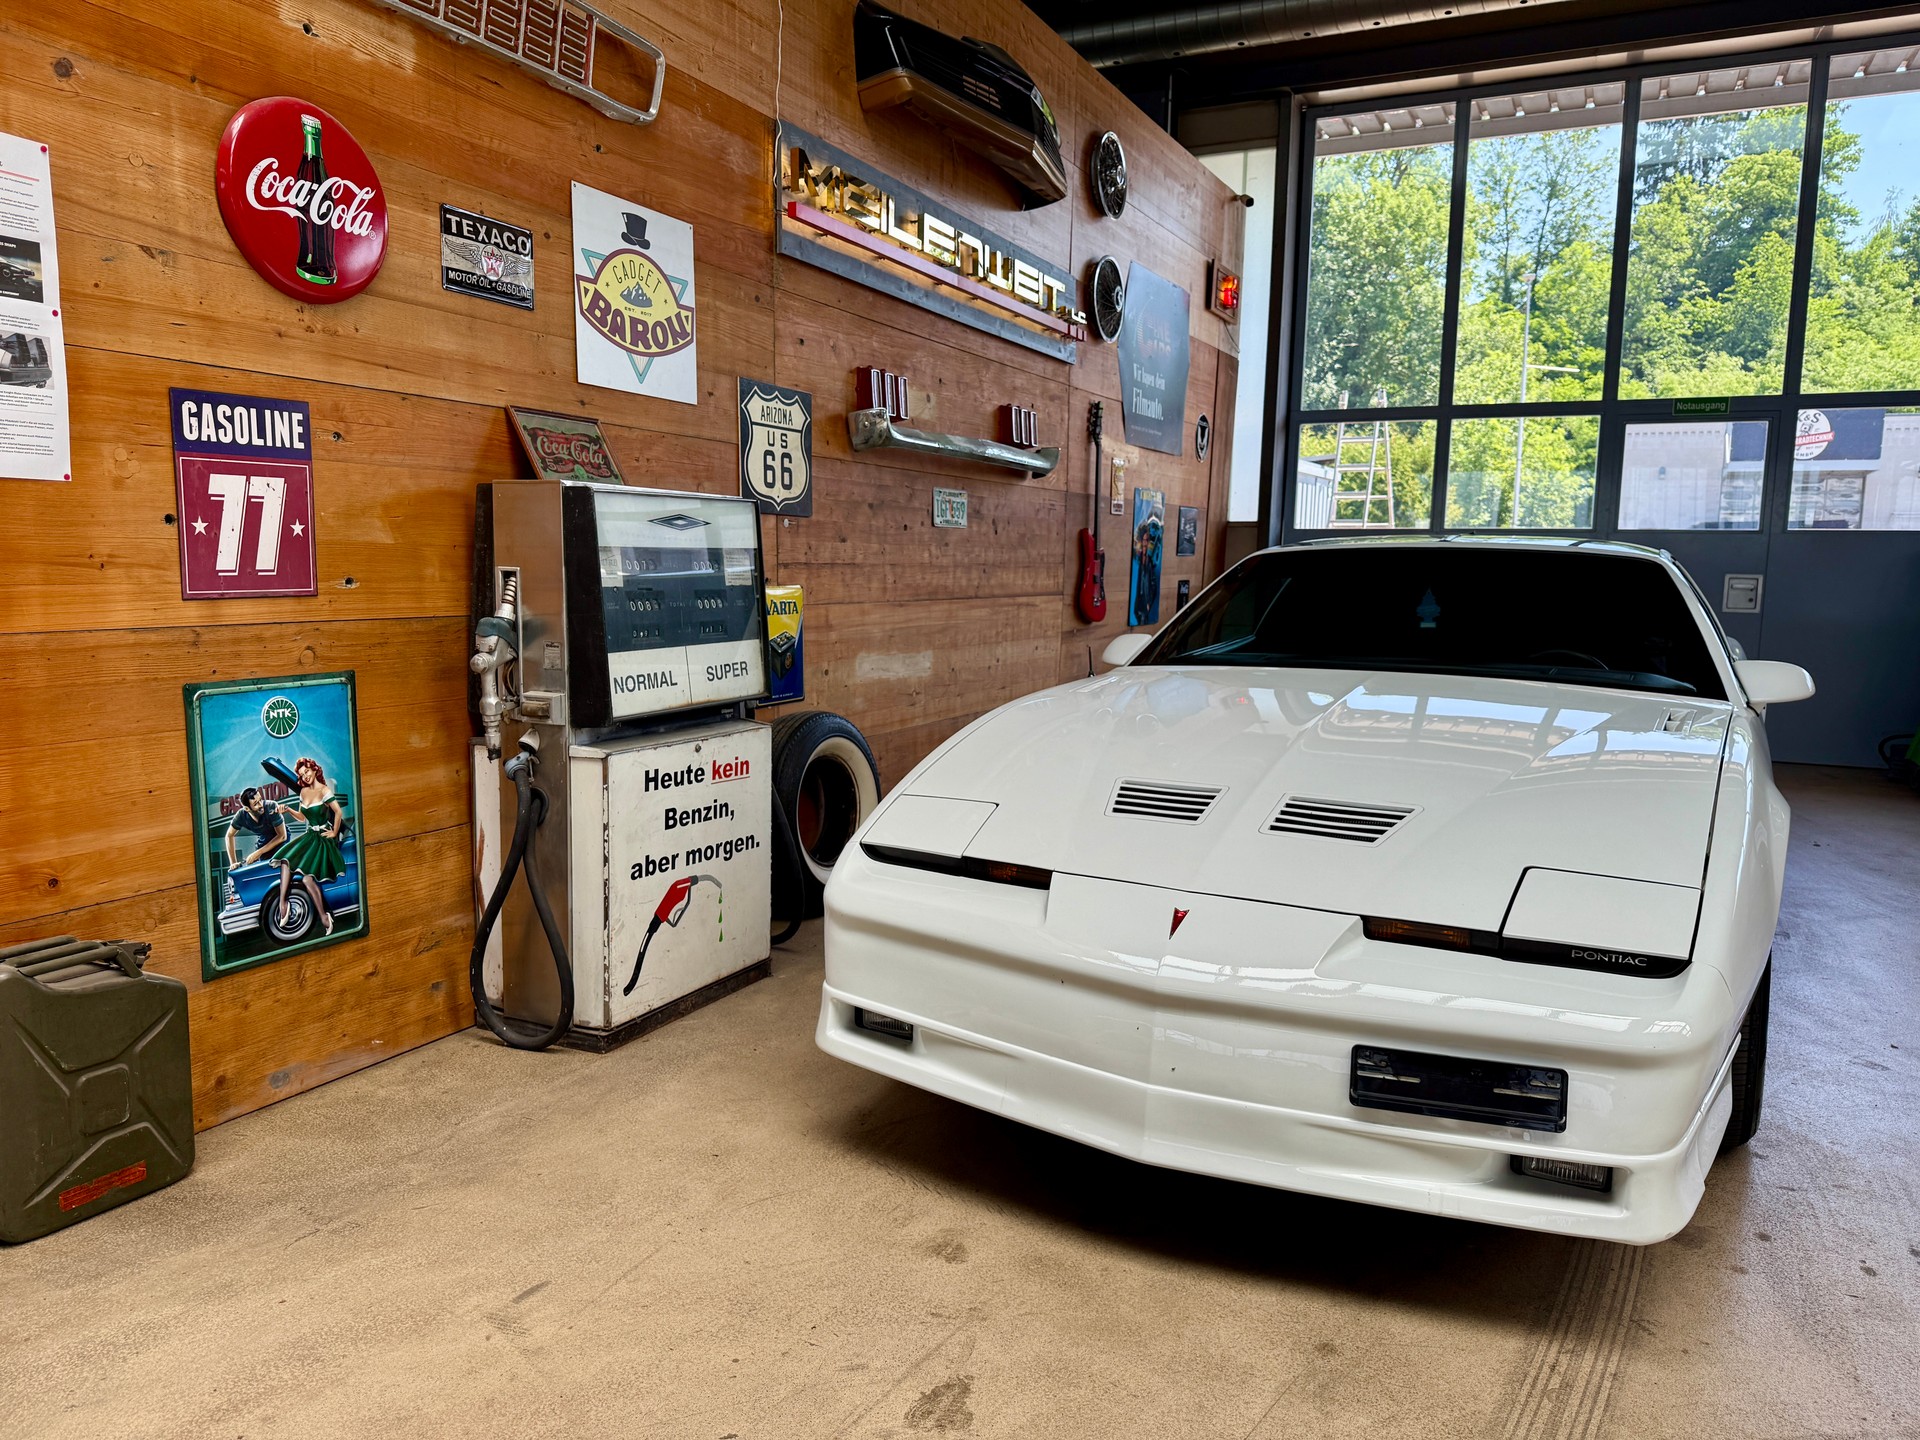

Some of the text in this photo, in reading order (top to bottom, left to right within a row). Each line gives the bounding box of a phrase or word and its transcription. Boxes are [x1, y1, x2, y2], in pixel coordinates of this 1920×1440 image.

[246, 157, 376, 237] Coca-Cola
[446, 213, 530, 255] TEXACO
[448, 270, 532, 299] MOTOR OIL GASOLINE
[612, 259, 662, 294] GADGET
[584, 286, 690, 351] BARON
[760, 405, 793, 426] ARIZONA
[1676, 402, 1726, 411] Notausgang
[181, 400, 305, 449] GASOLINE
[536, 435, 605, 464] Coca-Cola
[767, 430, 788, 449] US
[763, 449, 793, 490] 66
[766, 599, 799, 616] VARTA
[613, 670, 678, 695] NORMAL
[706, 660, 749, 682] SUPER
[269, 708, 292, 719] NTK
[644, 756, 750, 792] Heute kein
[664, 798, 735, 831] Benzin,
[630, 834, 761, 881] aber morgen.
[1570, 949, 1648, 967] PONTIAC
